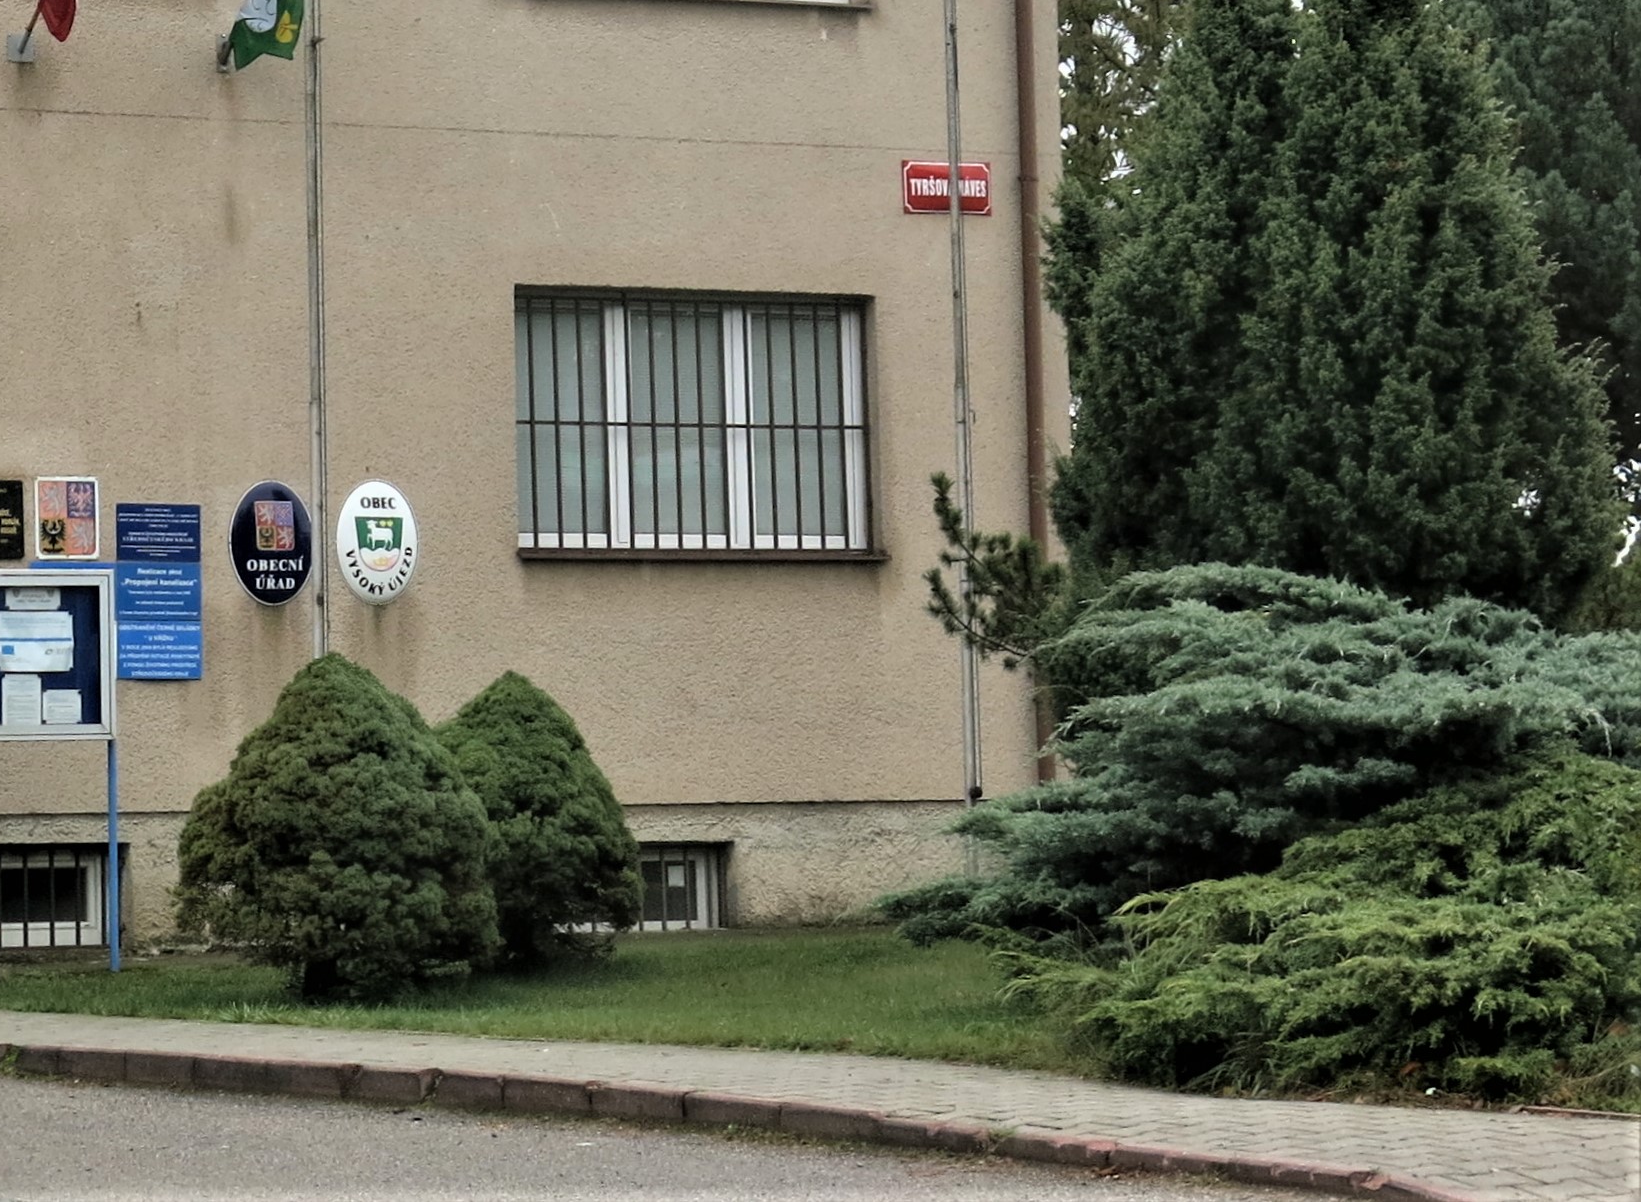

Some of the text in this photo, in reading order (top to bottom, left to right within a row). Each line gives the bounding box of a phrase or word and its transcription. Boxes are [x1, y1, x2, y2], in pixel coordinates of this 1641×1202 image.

[359, 496, 397, 510] OBEC
[246, 555, 304, 572] OBECNÍ
[345, 546, 414, 596] VYSOKÝ ÚJEZD
[255, 573, 296, 590] ÚŘAD
